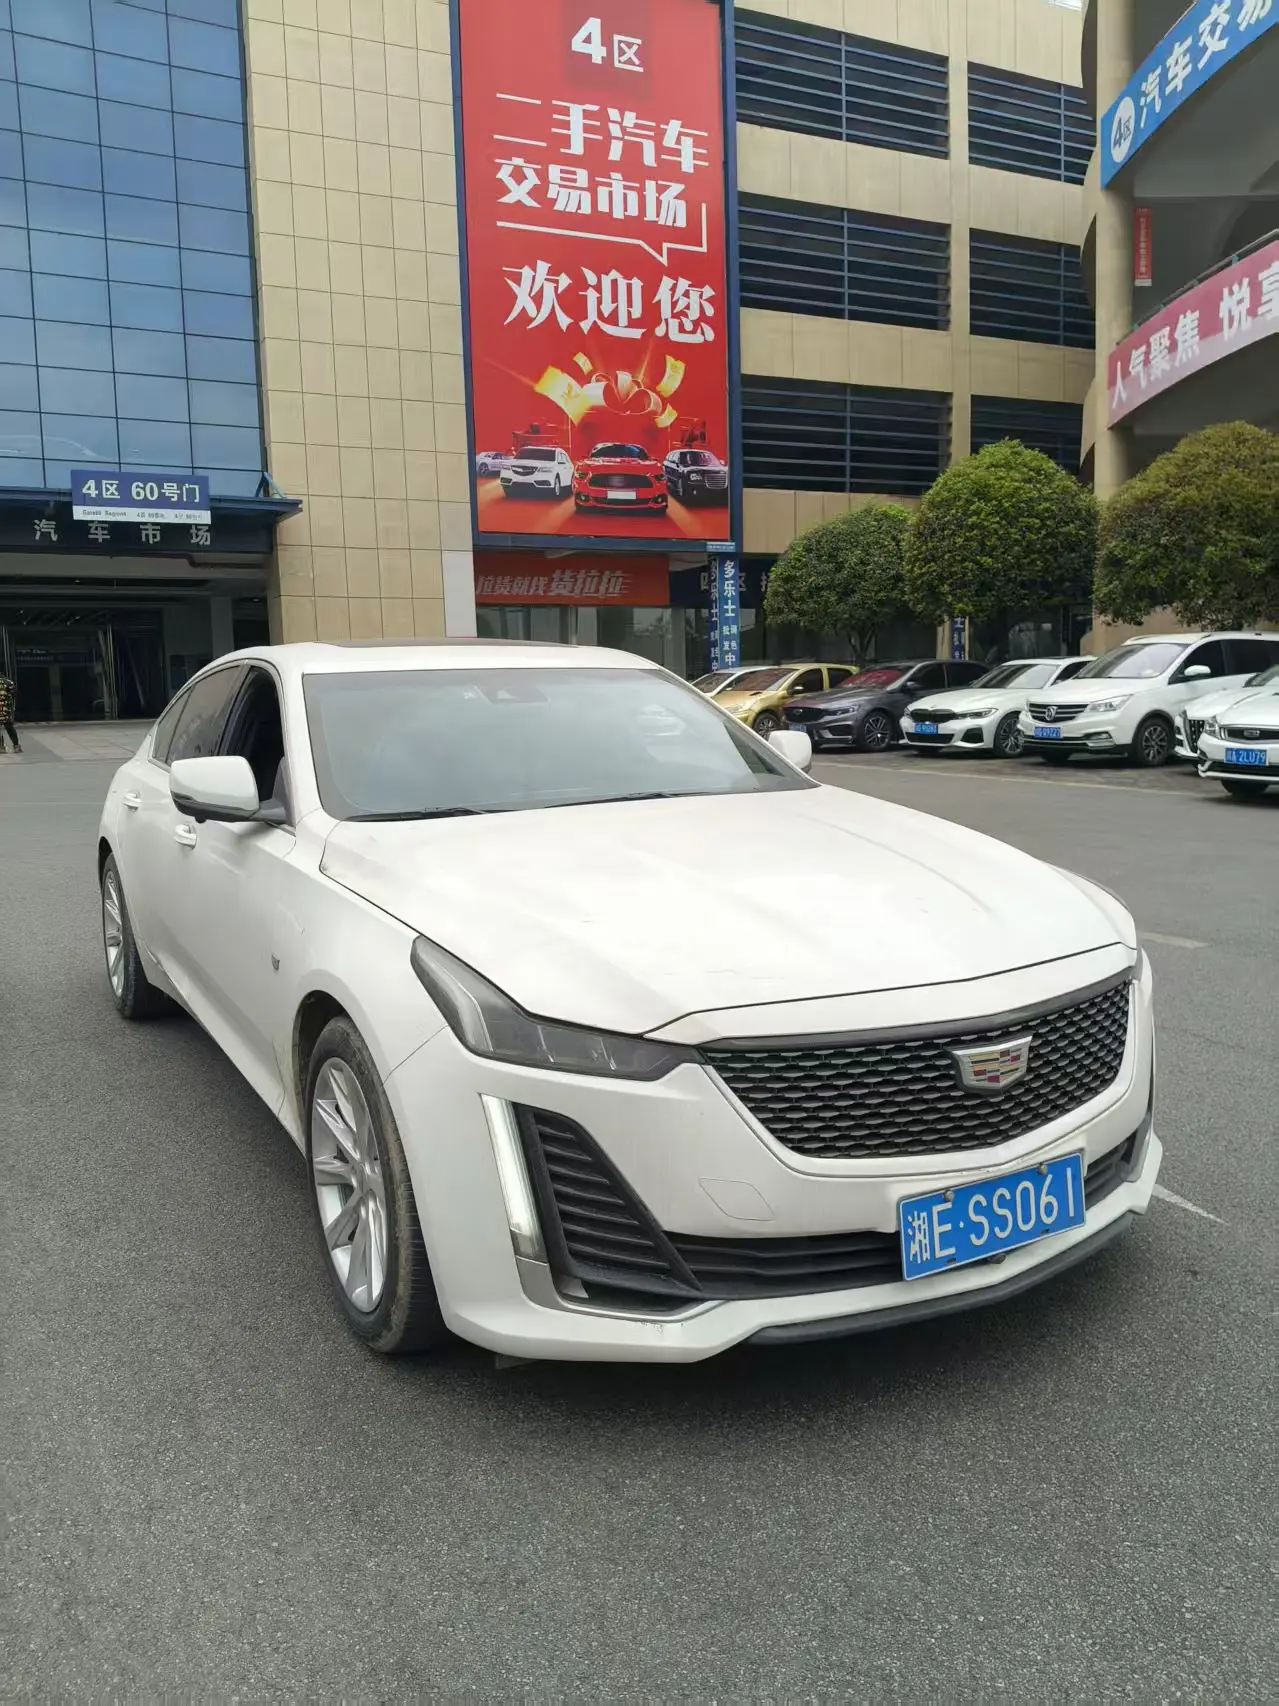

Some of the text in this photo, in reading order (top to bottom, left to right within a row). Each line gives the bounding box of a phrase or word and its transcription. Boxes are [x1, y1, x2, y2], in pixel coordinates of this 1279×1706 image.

[571, 17, 644, 72] 4区
[493, 93, 709, 173] 二手汽车
[1113, 116, 1131, 149] 4区
[494, 156, 687, 228] 交易市场
[502, 259, 716, 343] 欢迎您
[1112, 310, 1200, 409] 人气聚焦
[82, 480, 200, 502] 4区 60号门
[34, 519, 210, 545] 汽车市场
[724, 560, 737, 617] 多乐士
